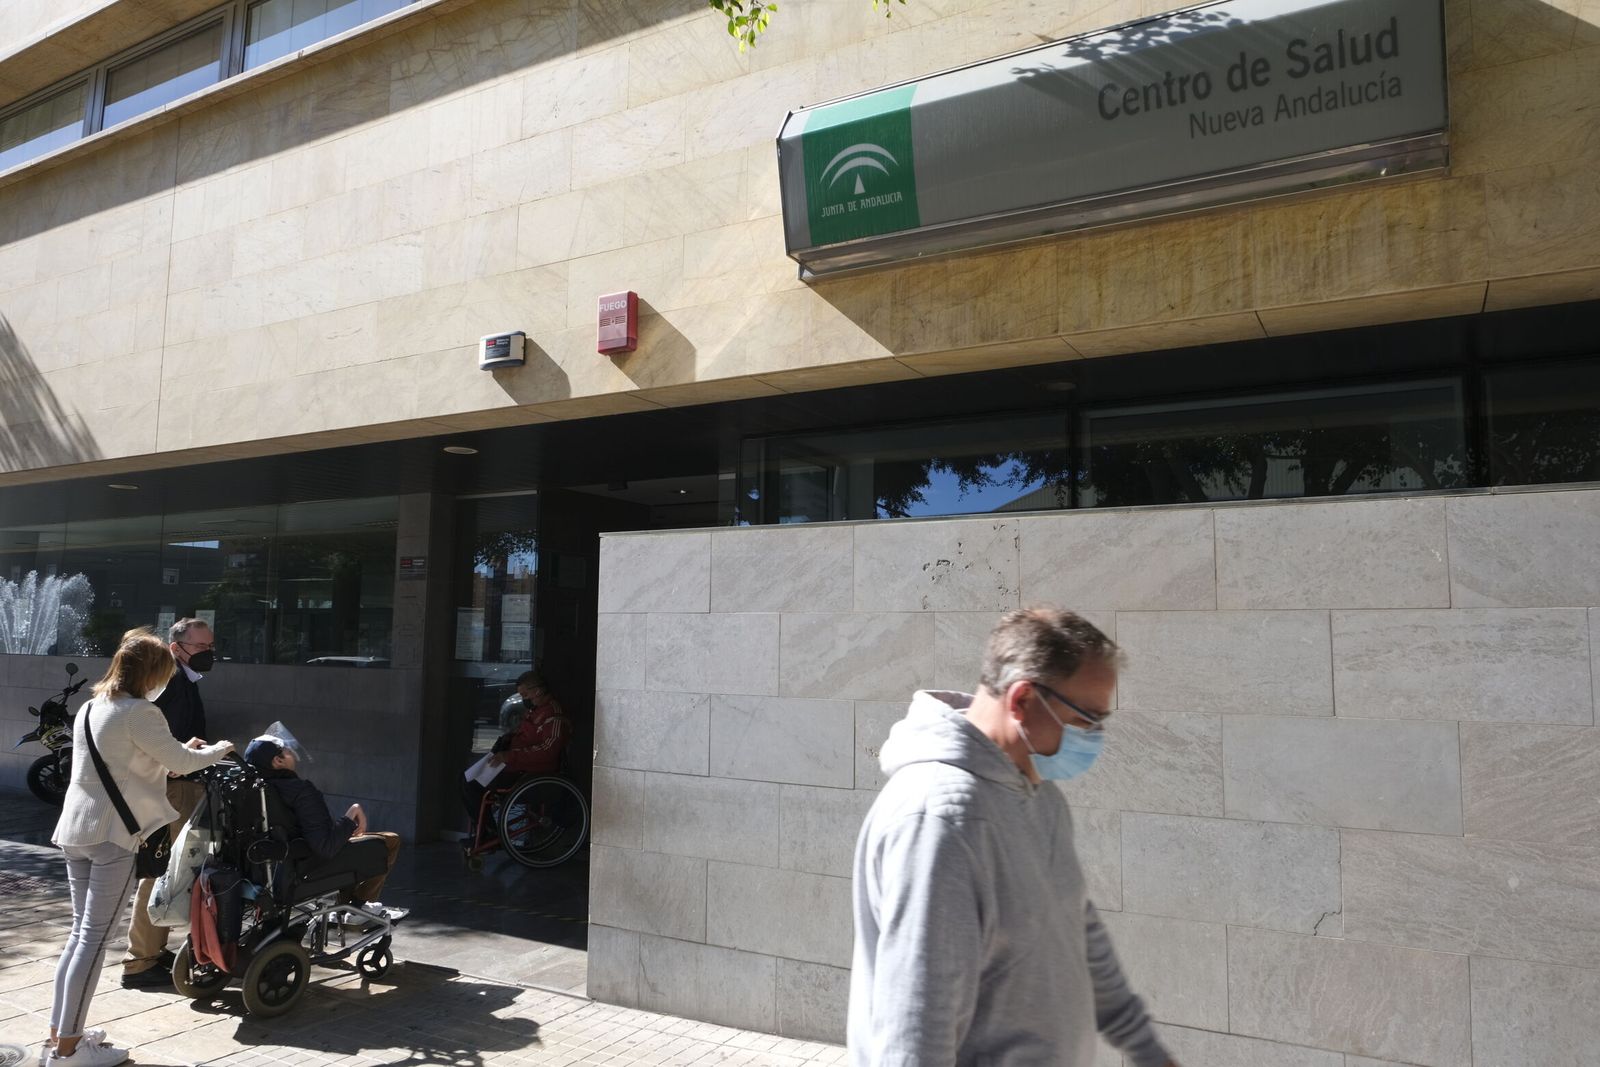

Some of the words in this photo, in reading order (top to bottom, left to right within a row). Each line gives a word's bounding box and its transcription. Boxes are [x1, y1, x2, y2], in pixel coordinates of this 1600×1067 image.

[1098, 71, 1212, 121] Centro
[1227, 51, 1271, 92] de
[1286, 16, 1399, 79] Salud
[1189, 105, 1264, 139] Nueva
[1274, 70, 1403, 122] Andalucía
[821, 203, 845, 218] JUNTA
[847, 200, 858, 212] DE
[860, 191, 903, 209] ANDALUCIA
[599, 300, 627, 313] FUEGO
